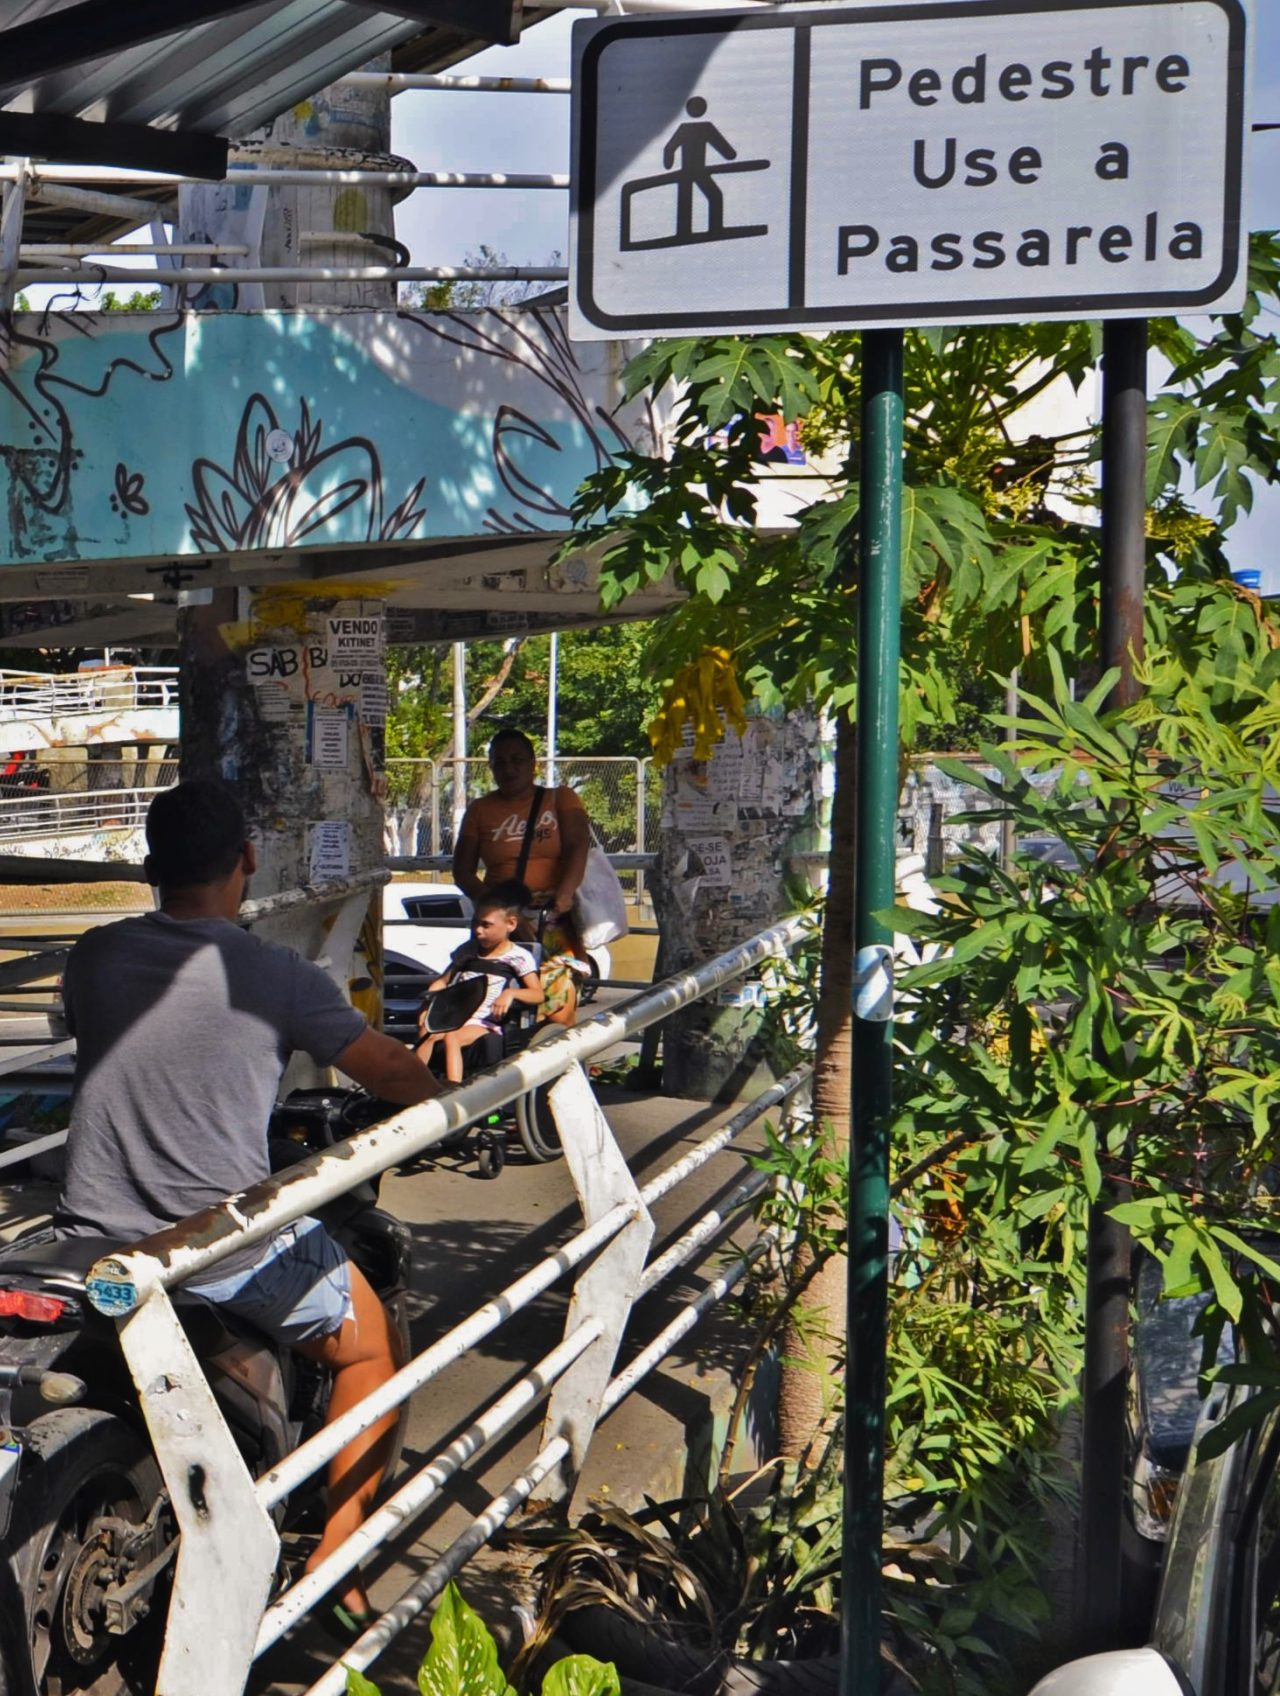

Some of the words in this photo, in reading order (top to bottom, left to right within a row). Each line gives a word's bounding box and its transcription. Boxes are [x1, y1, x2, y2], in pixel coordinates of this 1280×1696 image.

[858, 46, 1191, 110] Pedestre
[912, 137, 1043, 189] Use
[1093, 141, 1130, 180] a
[837, 211, 1203, 276] Passarela
[329, 620, 378, 635] VENDO
[337, 637, 376, 648] KITINET
